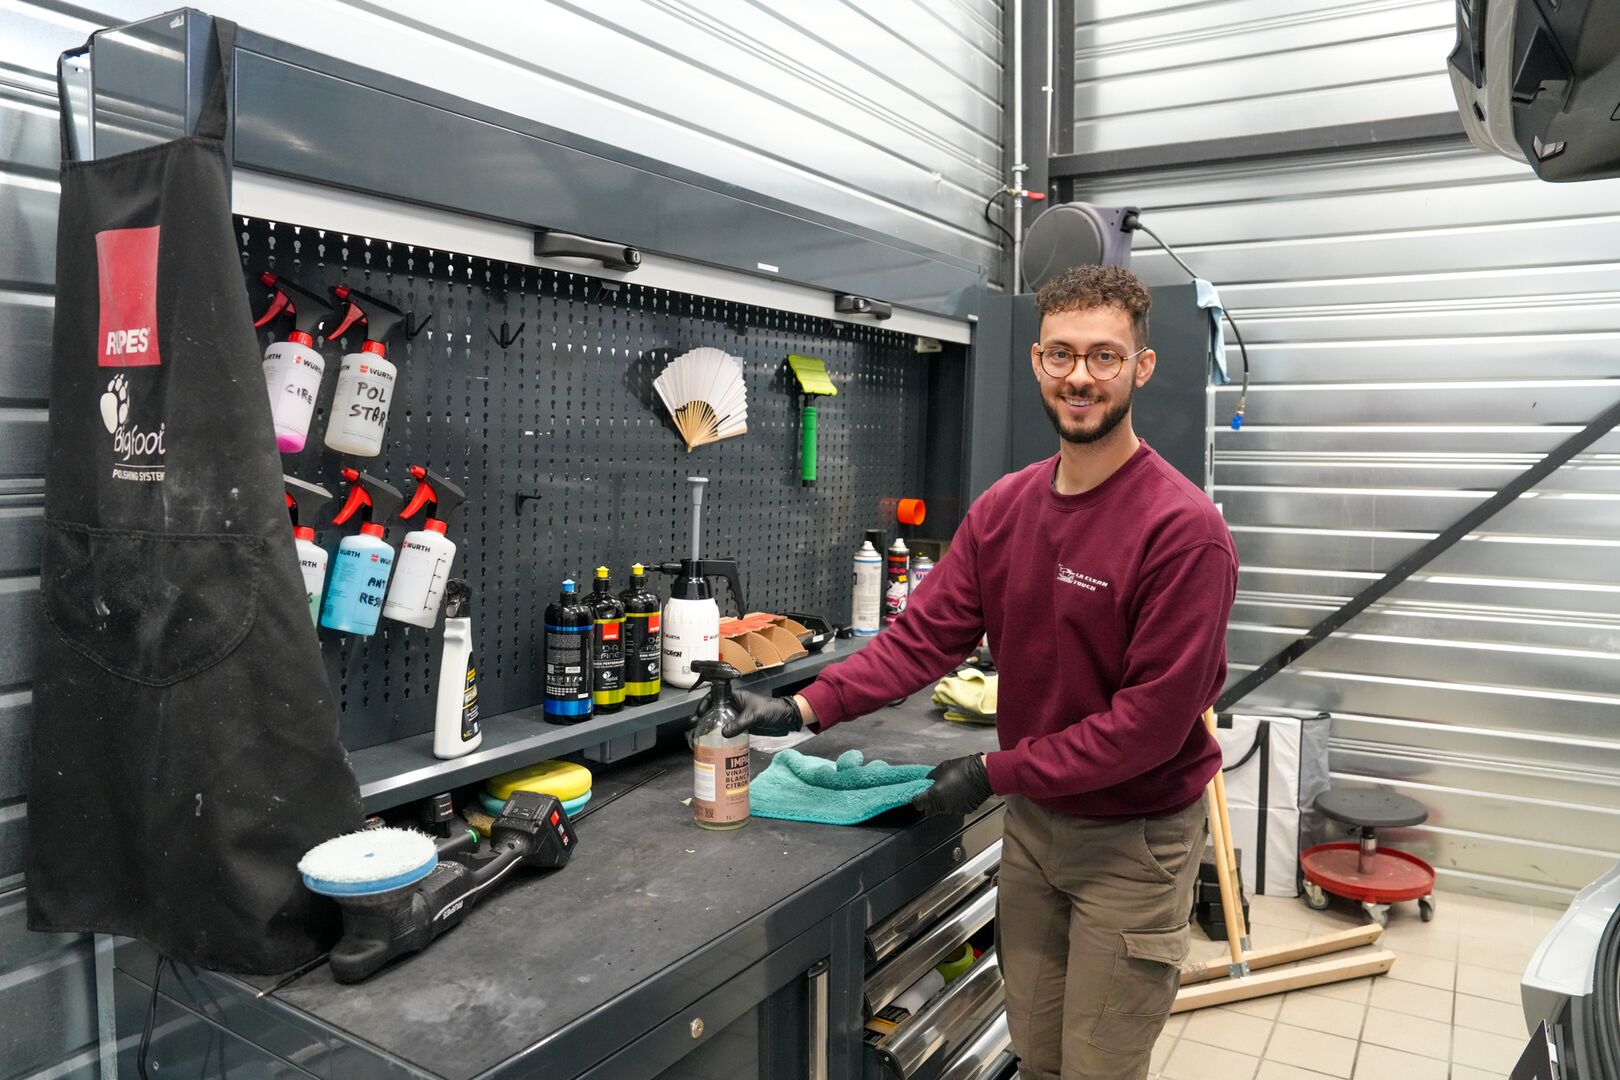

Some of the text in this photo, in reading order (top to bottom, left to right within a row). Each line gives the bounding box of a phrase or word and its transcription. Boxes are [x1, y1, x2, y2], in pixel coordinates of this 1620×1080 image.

[285, 383, 313, 405] CIRE
[357, 381, 386, 403] POL
[1073, 580, 1097, 591] TOUCH
[1084, 575, 1109, 588] CLEAN
